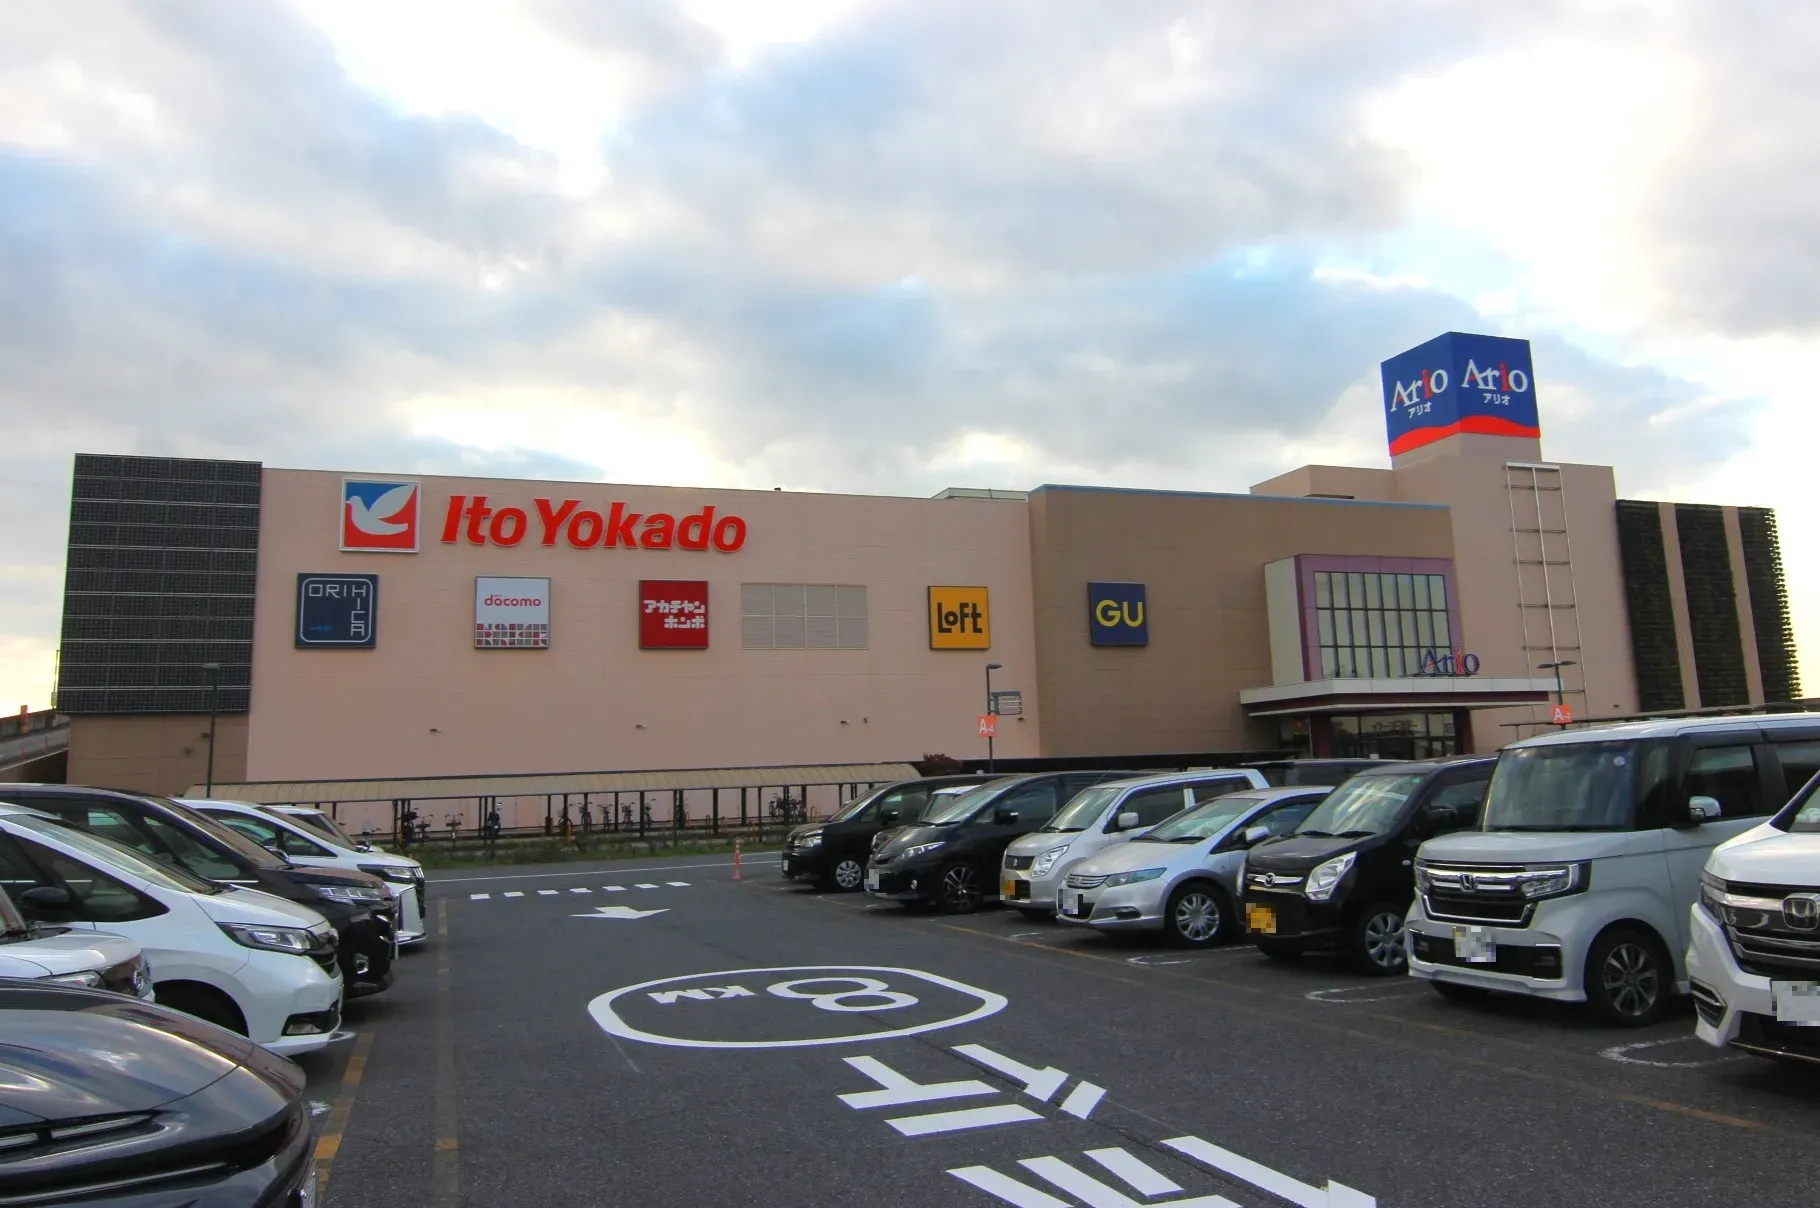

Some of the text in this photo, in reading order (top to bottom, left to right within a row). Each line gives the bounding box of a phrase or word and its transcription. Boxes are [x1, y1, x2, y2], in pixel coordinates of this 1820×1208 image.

[1390, 368, 1448, 412] Ario
[1461, 358, 1528, 393] Ario
[1408, 401, 1432, 419] アリオ
[1483, 393, 1511, 405] アリオ
[440, 494, 747, 553] Ito Yokado
[484, 594, 541, 607] docomo
[643, 599, 705, 613] アカチャン
[1096, 599, 1144, 627] GU
[1420, 645, 1480, 675] Ario
[766, 977, 919, 1012] 8
